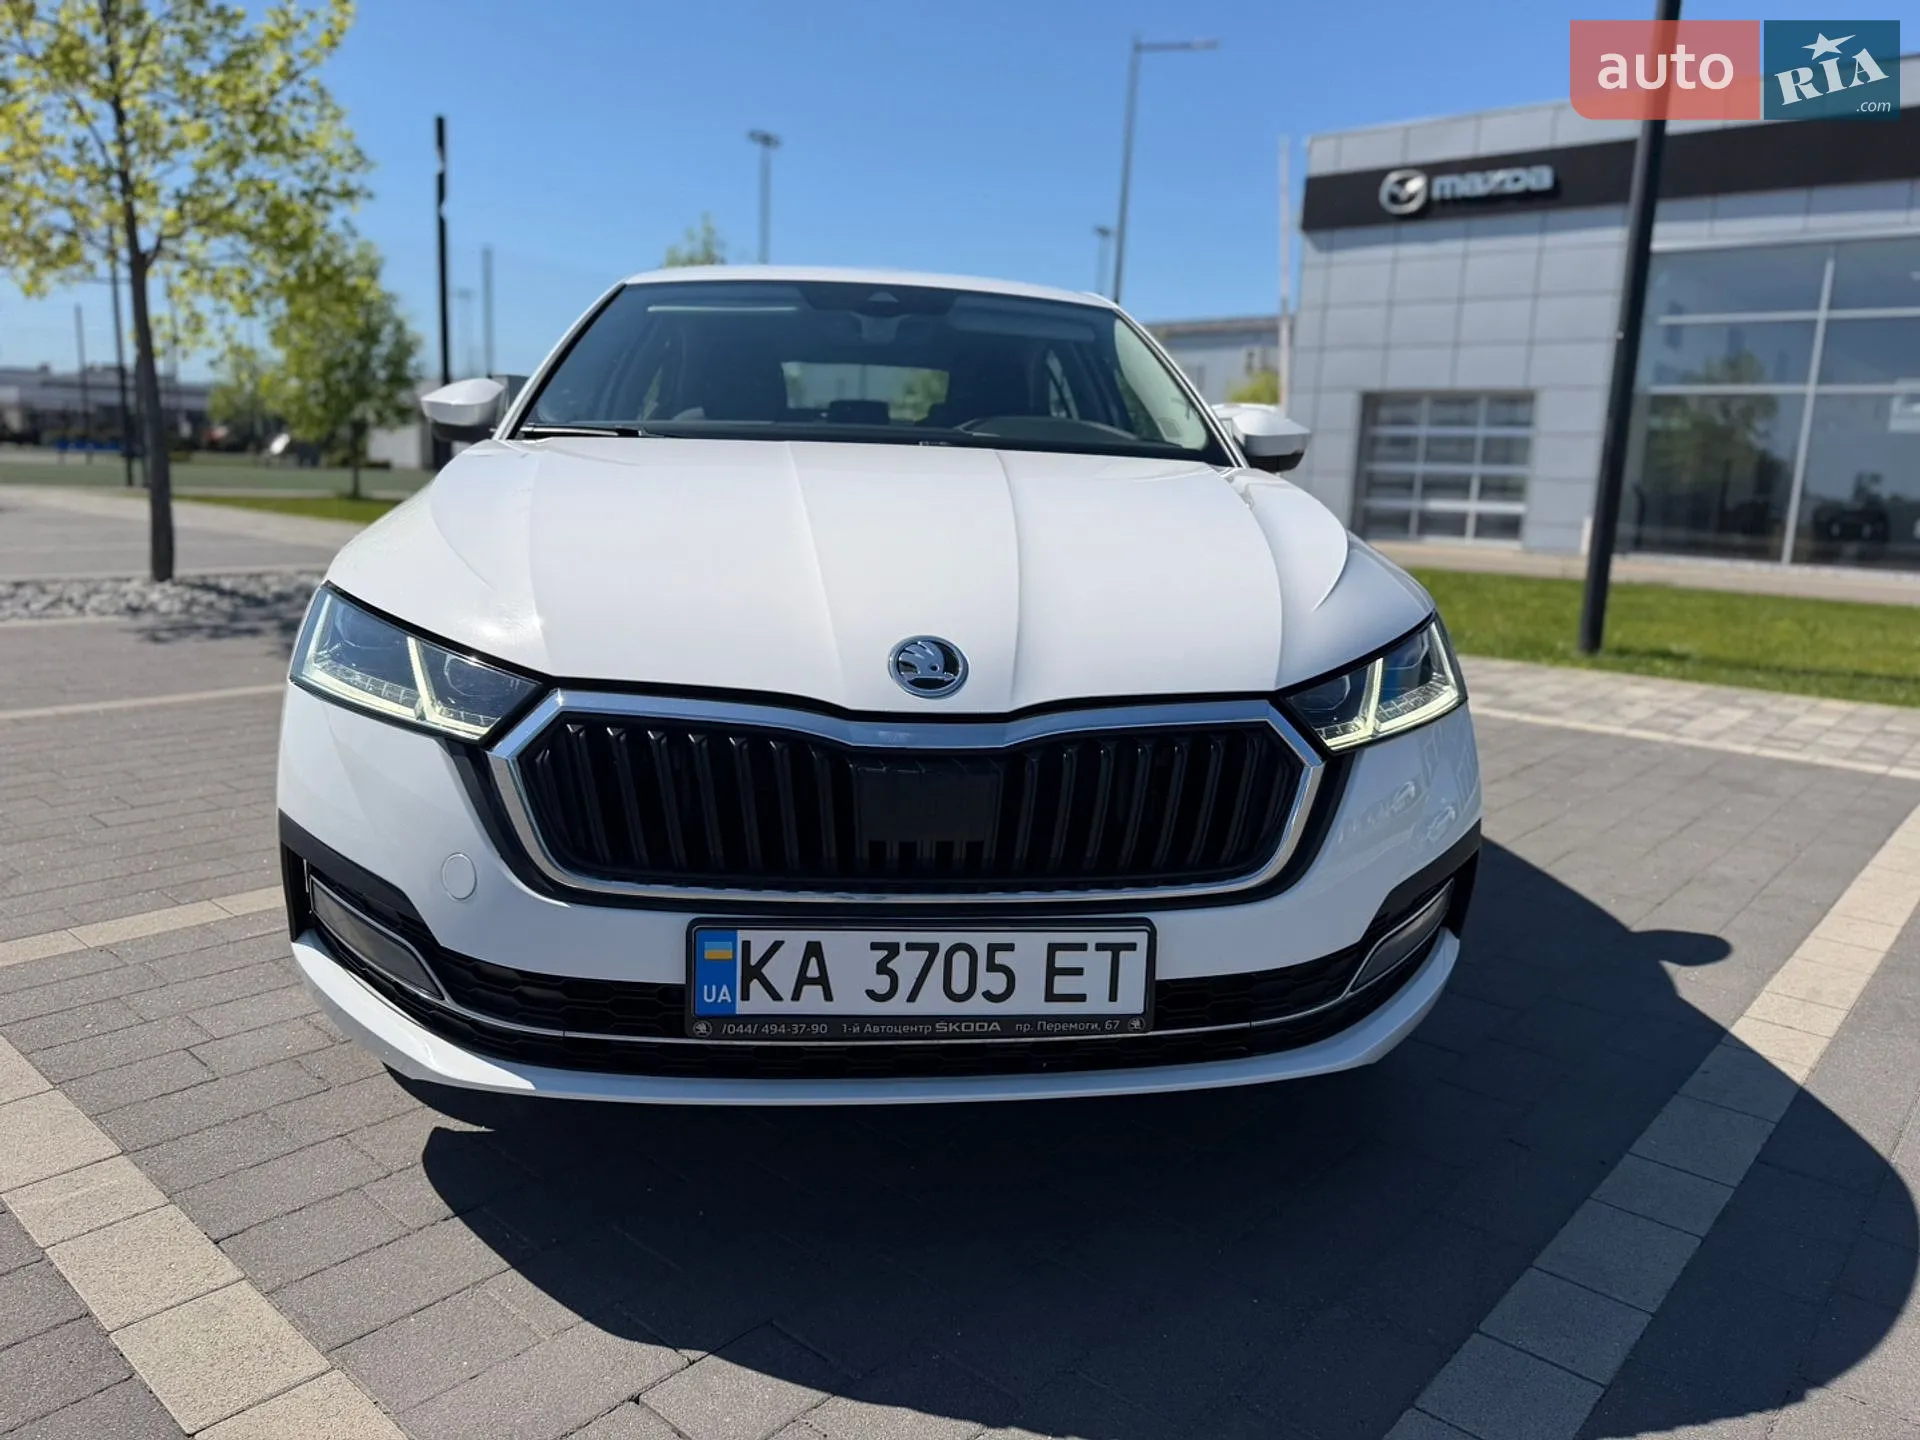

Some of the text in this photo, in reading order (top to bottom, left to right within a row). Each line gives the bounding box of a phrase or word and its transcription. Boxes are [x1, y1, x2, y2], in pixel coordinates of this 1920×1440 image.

[1431, 164, 1555, 201] mazda
[740, 940, 1137, 1003] KA 3705 ET
[703, 984, 732, 1003] UA
[761, 1023, 828, 1035] 494-37-90
[863, 1022, 933, 1036] Автоцентр
[1015, 1023, 1034, 1034] пр.
[1105, 1019, 1121, 1031] 67
